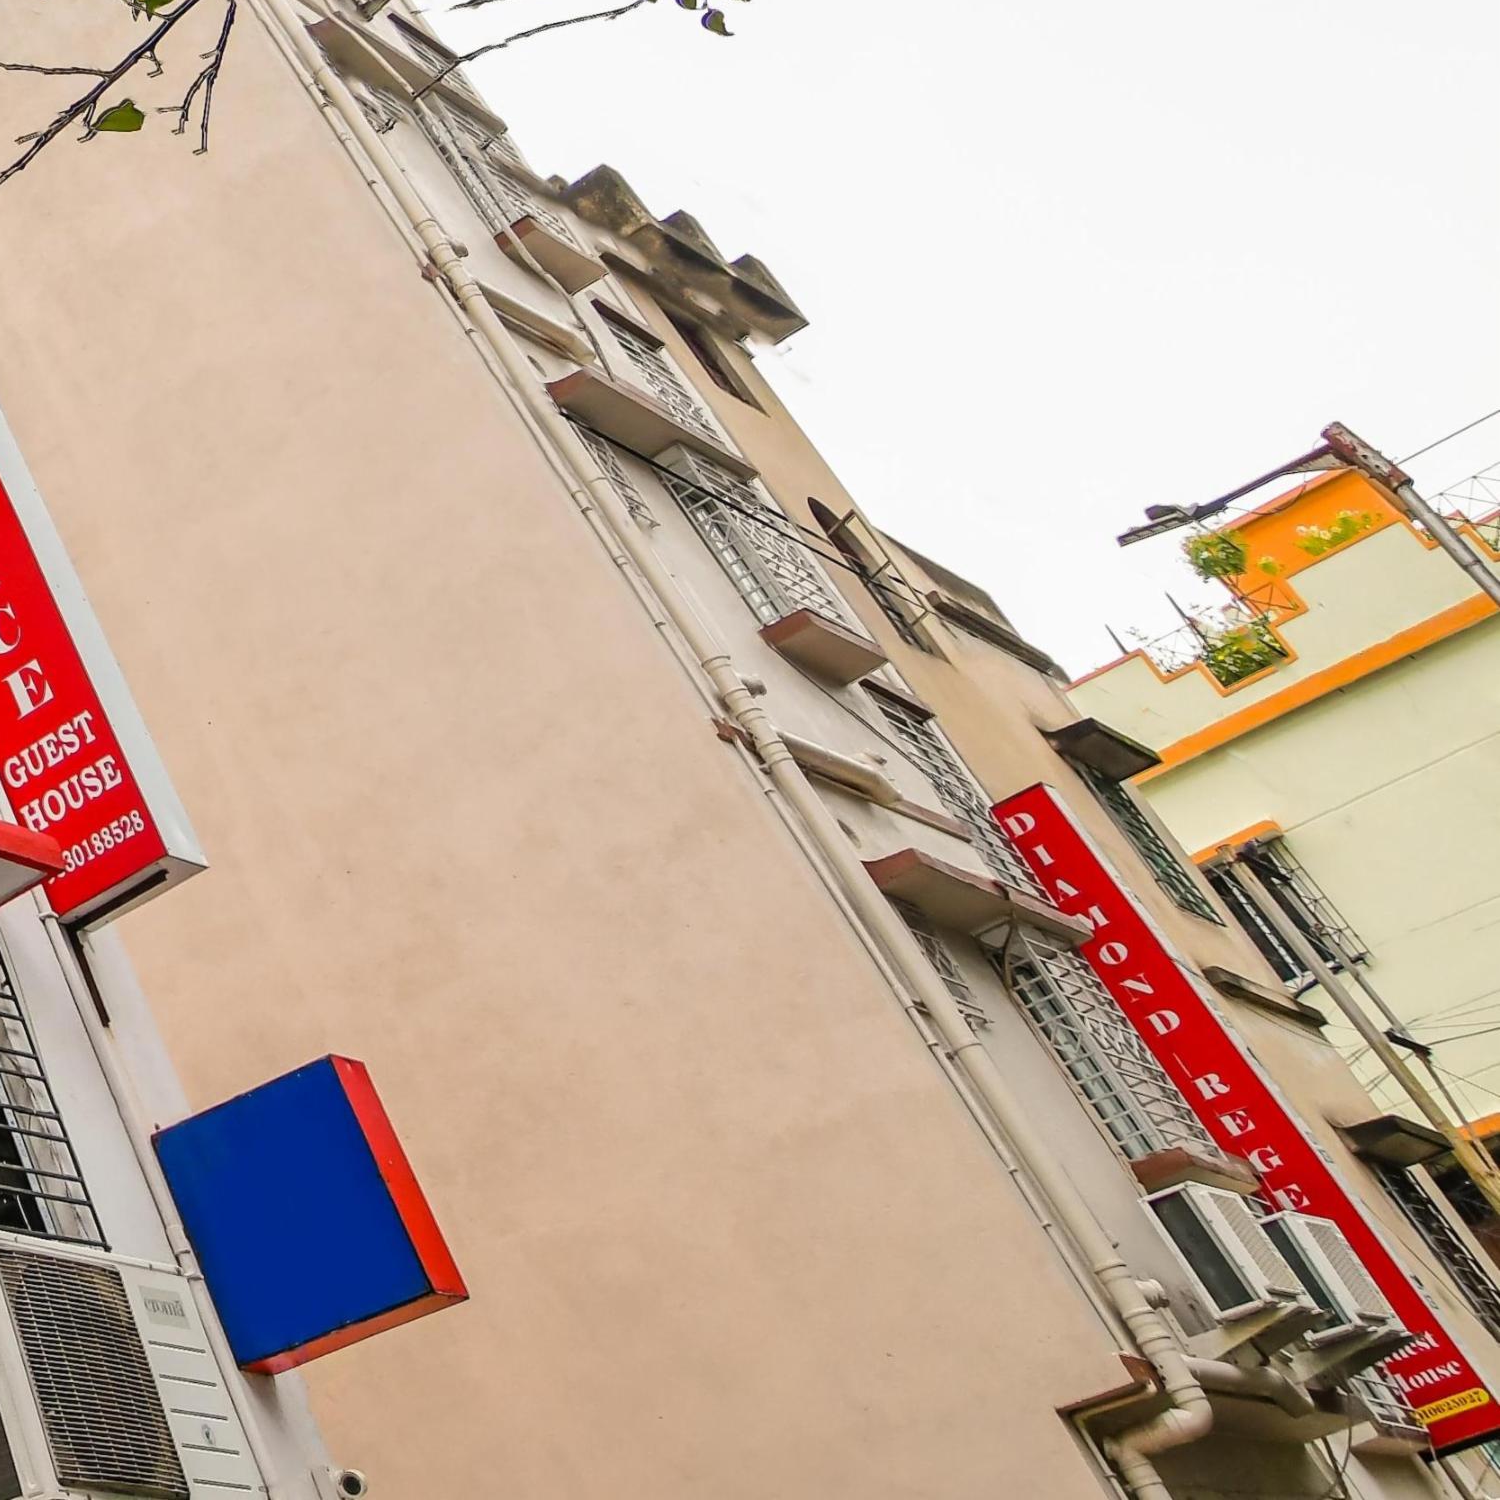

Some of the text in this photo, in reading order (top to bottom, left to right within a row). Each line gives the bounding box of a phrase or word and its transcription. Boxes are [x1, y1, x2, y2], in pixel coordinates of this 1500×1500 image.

[4, 710, 96, 788] GUEST
[19, 755, 122, 832] HOUSE
[48, 809, 145, 884] 30188528
[1004, 812, 1181, 1036] DIAMOND
